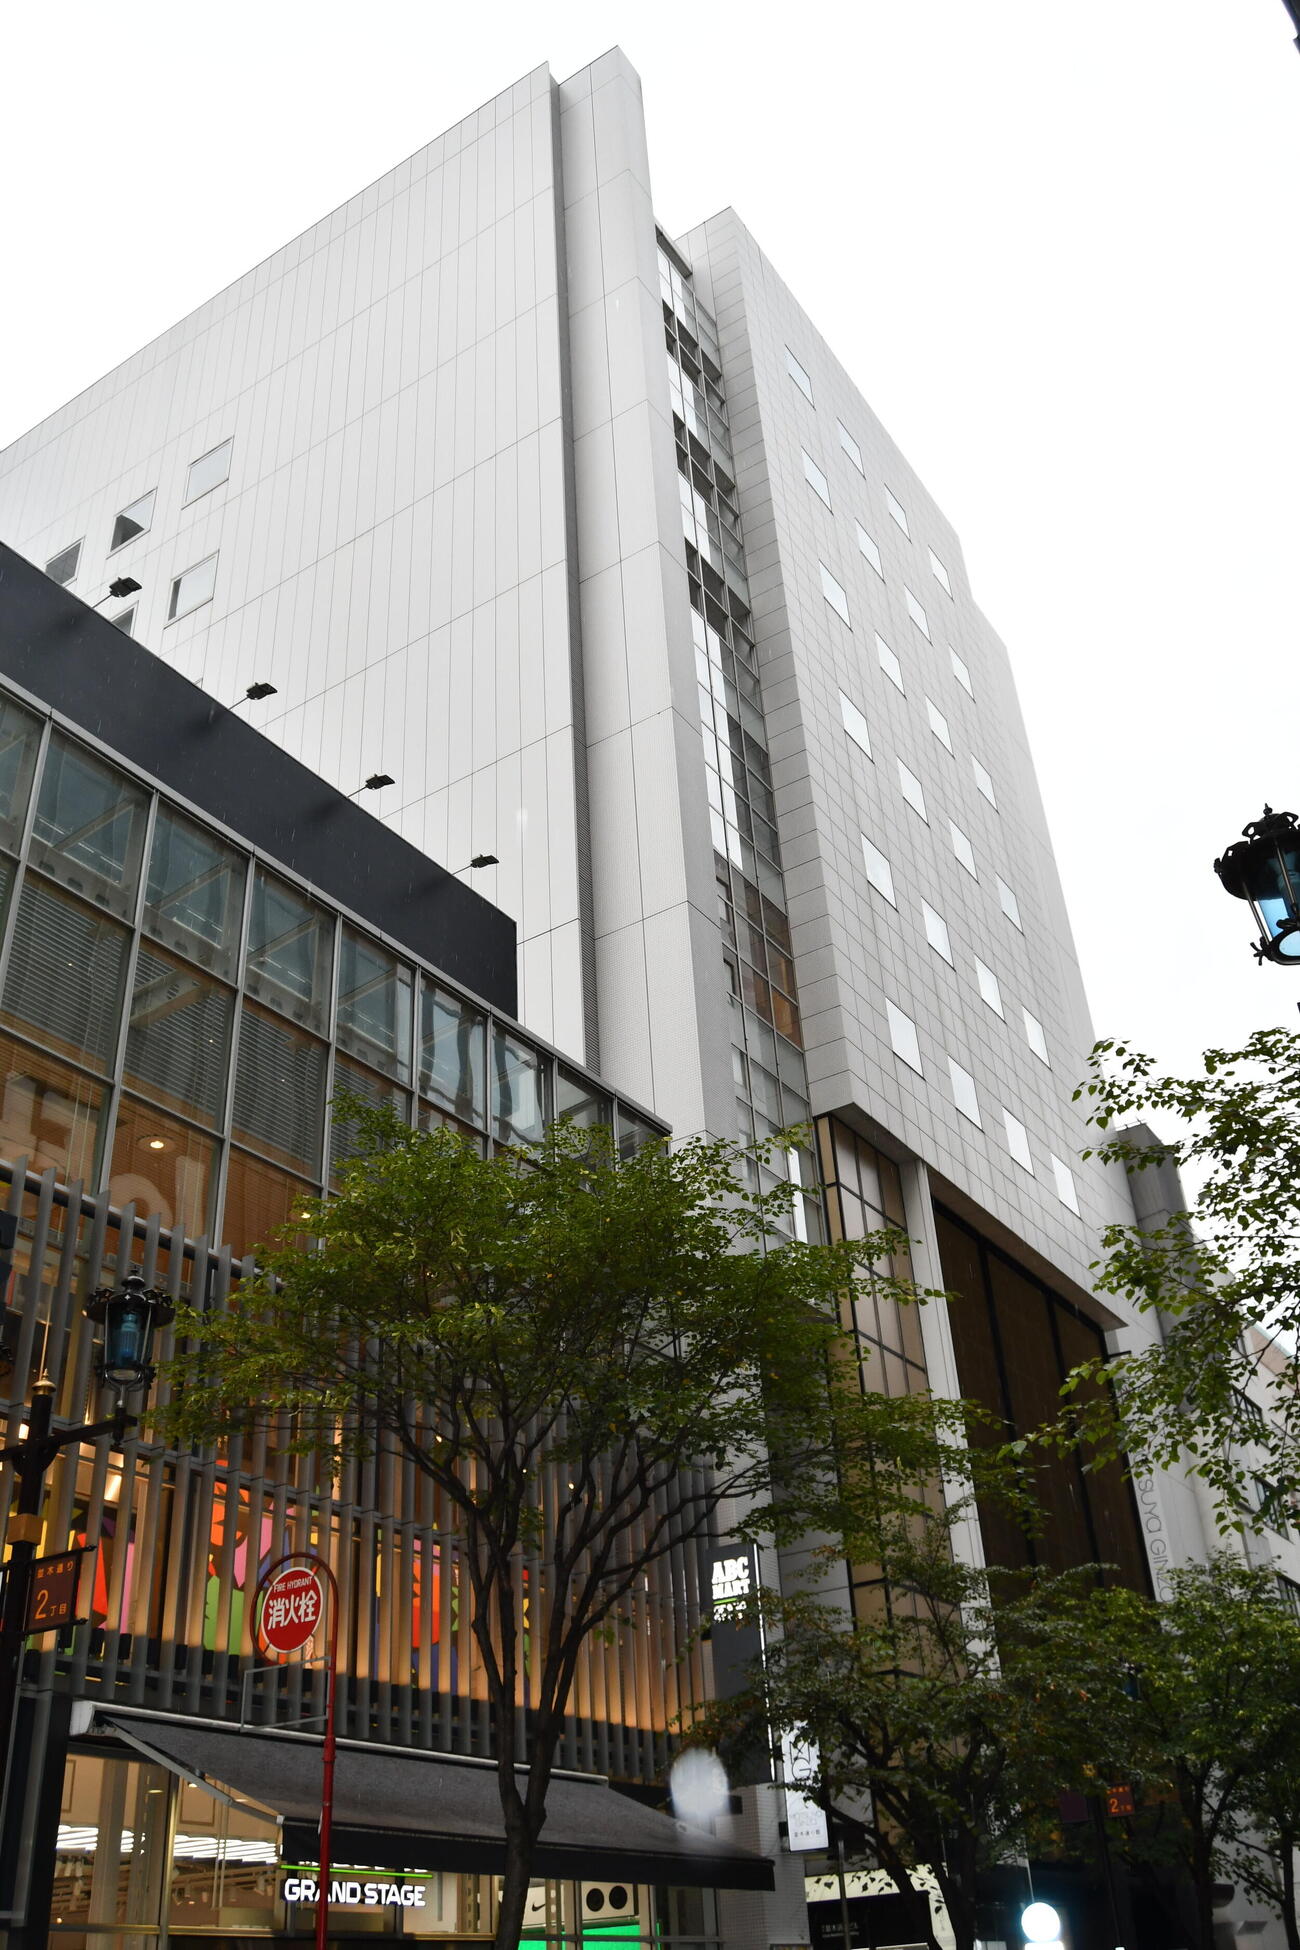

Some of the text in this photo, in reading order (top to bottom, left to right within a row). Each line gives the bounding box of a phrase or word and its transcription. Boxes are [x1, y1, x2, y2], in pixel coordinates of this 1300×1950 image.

[711, 1556, 750, 1585] ABC
[273, 1576, 313, 1593] FIRE HYDRANT
[711, 1578, 750, 1600] MART
[268, 1590, 318, 1630] 消火栓
[363, 1882, 426, 1907] STAGE
